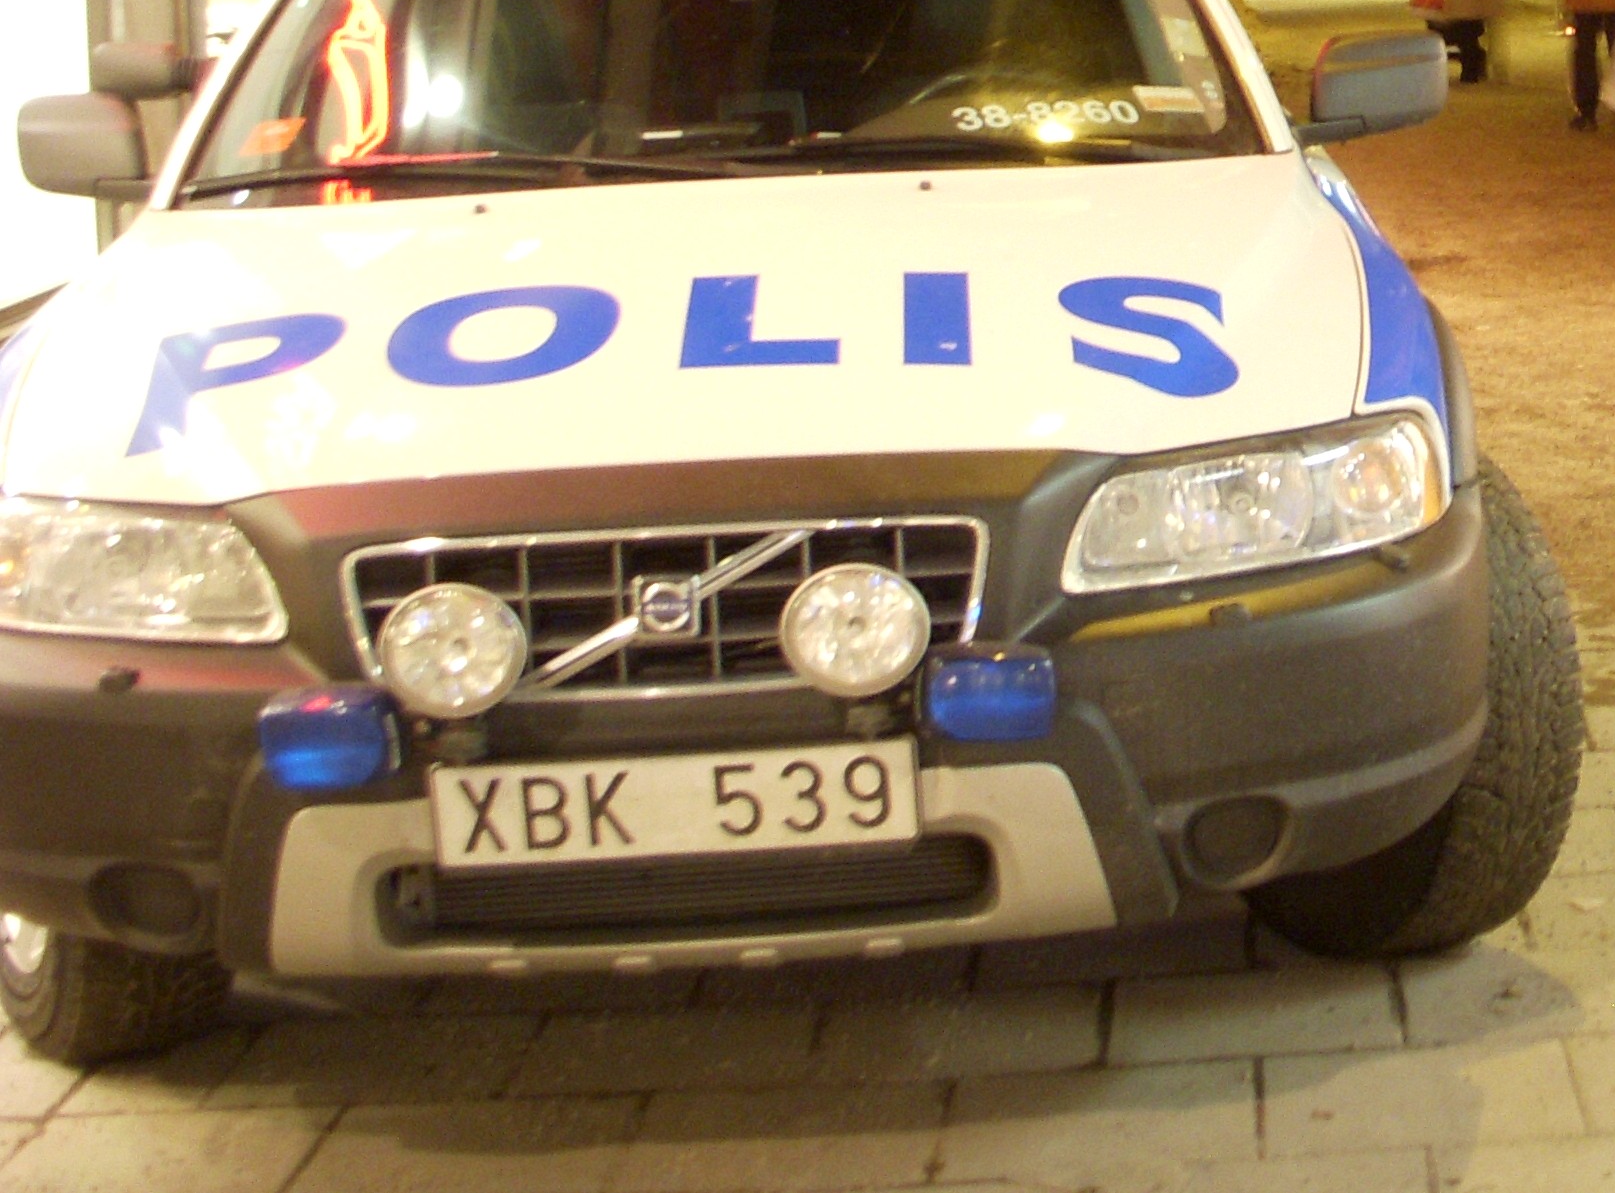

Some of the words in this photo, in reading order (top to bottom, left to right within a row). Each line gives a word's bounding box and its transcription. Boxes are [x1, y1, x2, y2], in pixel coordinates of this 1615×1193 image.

[952, 100, 1140, 131] 38-8260
[125, 272, 1240, 458] POLIS
[459, 770, 635, 854] XBK
[713, 755, 893, 837] 539
